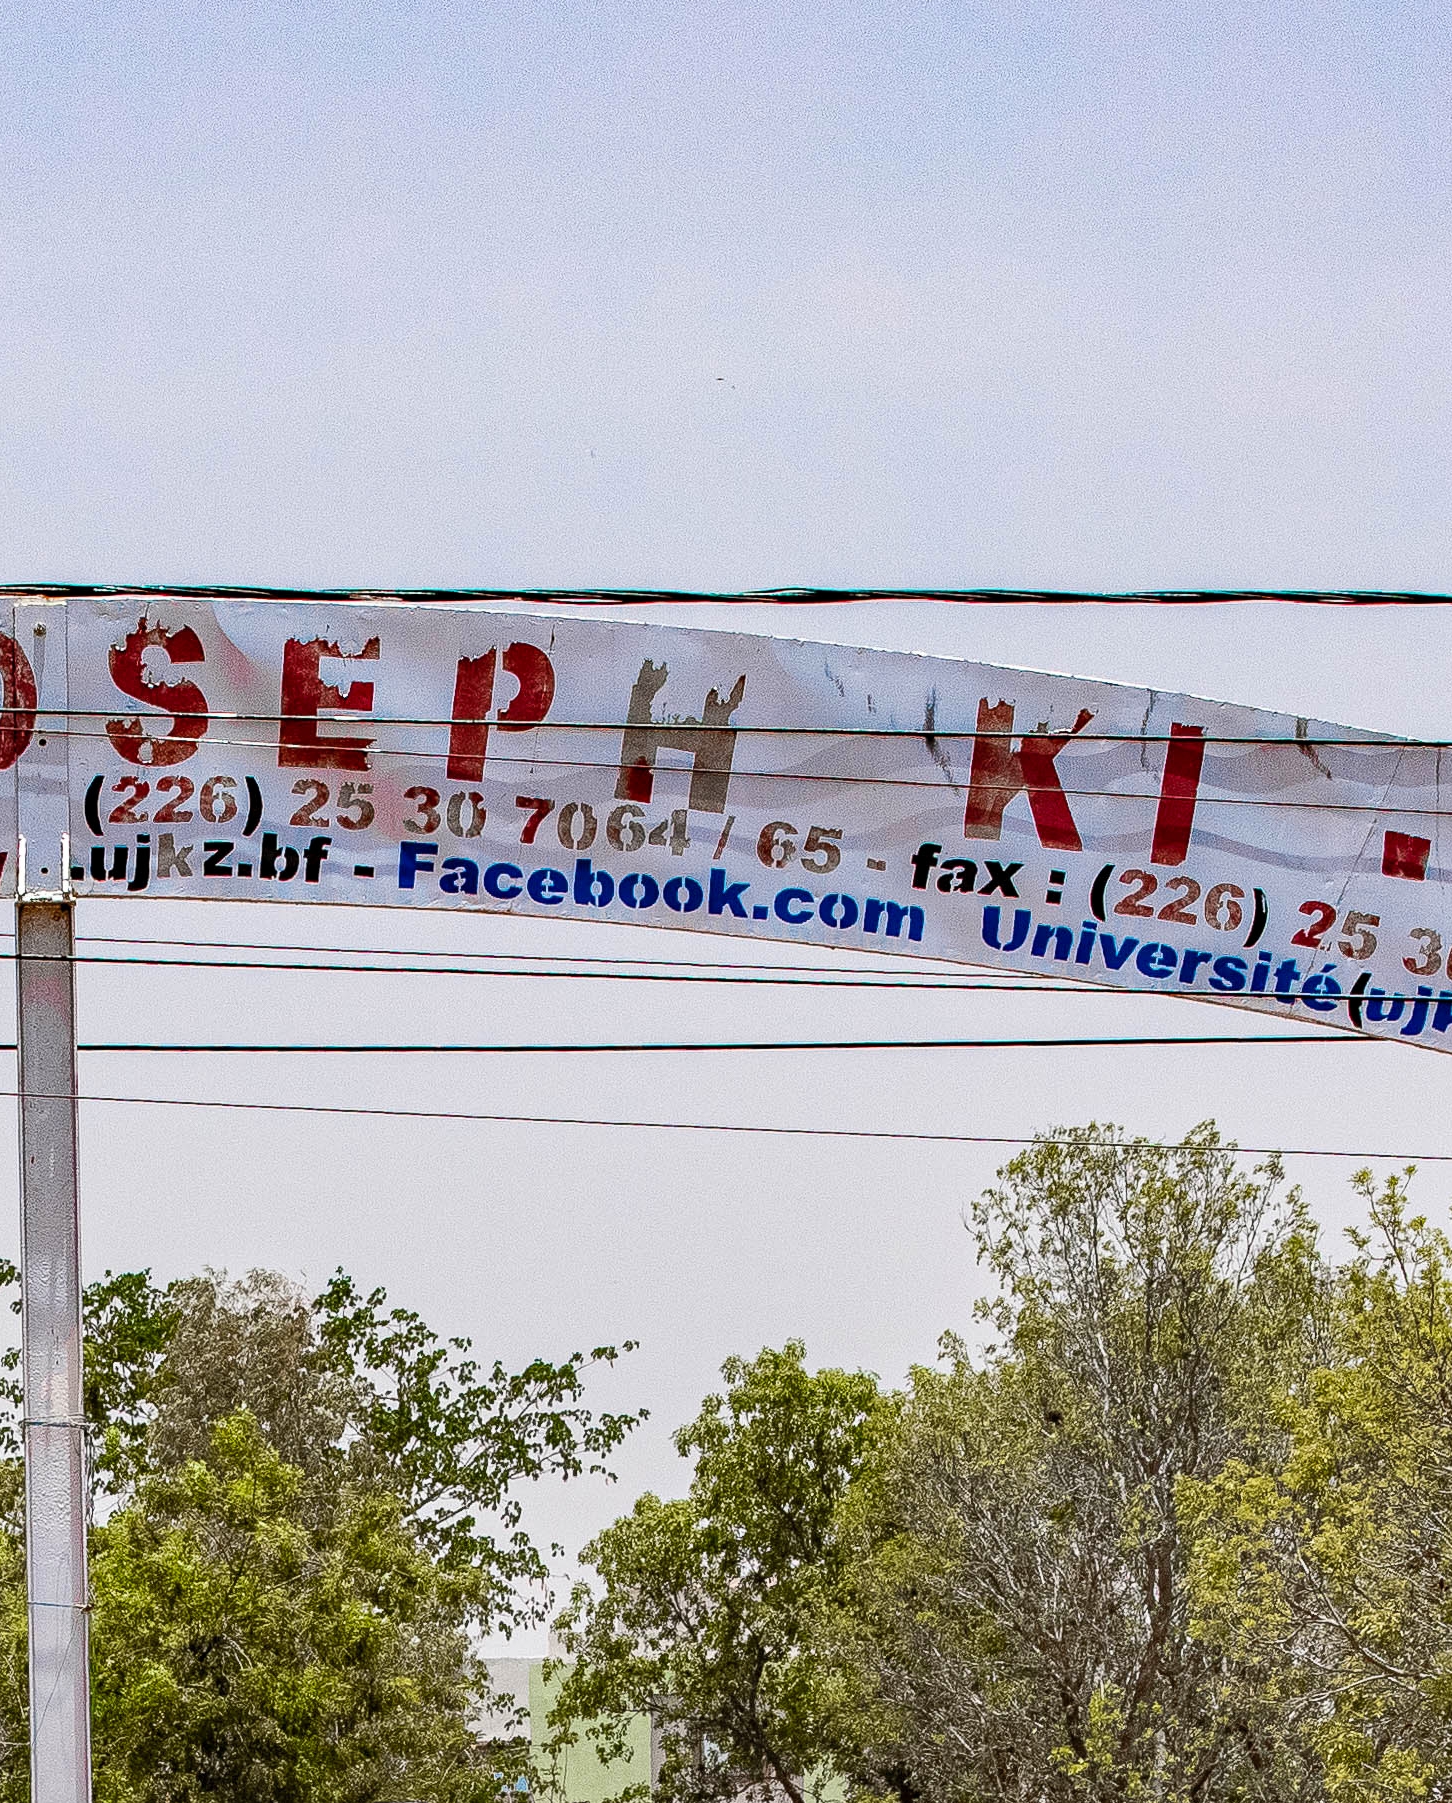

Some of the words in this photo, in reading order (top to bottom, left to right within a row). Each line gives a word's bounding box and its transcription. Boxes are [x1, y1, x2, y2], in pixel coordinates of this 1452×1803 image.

[85, 773, 264, 837] (226)
[291, 776, 375, 831] 25
[404, 785, 487, 839] 30
[756, 820, 845, 874] 65
[910, 841, 1024, 899] fax
[1090, 863, 1269, 949] (226)
[1291, 900, 1381, 960] 25
[399, 841, 925, 944] Facebook.com
